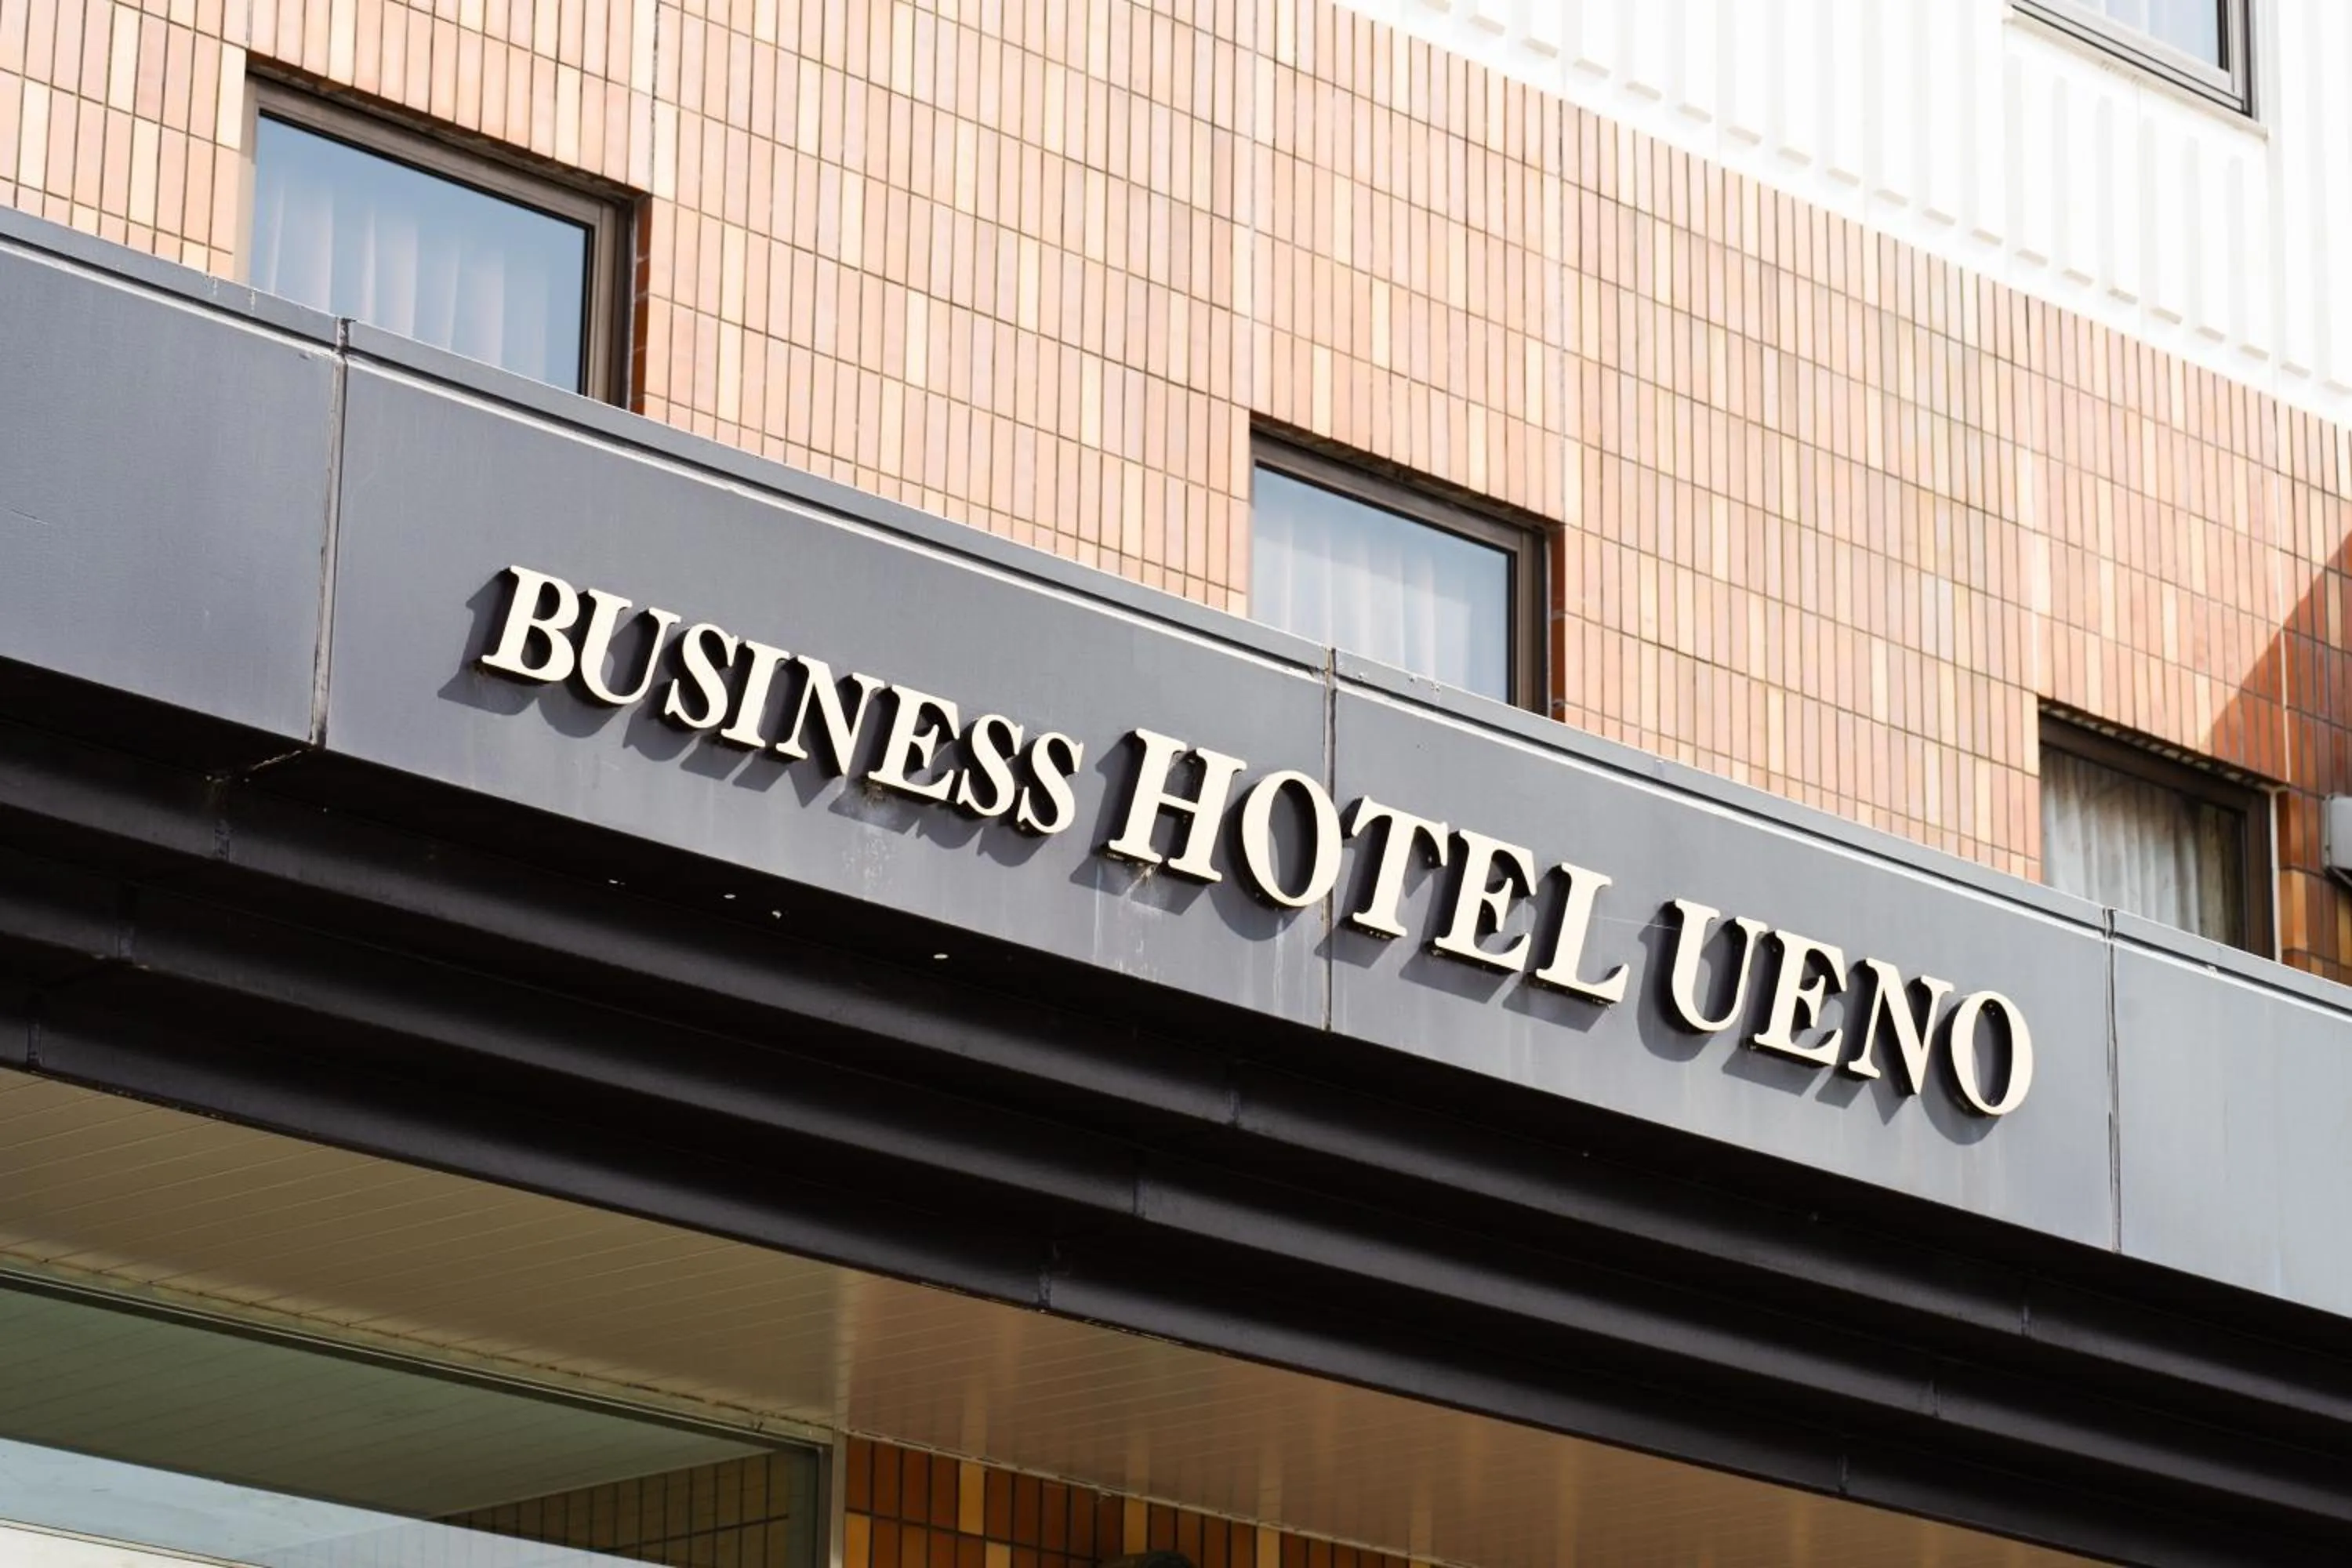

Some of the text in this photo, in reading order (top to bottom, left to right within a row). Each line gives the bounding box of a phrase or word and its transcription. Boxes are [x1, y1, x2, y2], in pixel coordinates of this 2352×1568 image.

[481, 564, 2034, 1116] BUSINESS HOTEL UENO
